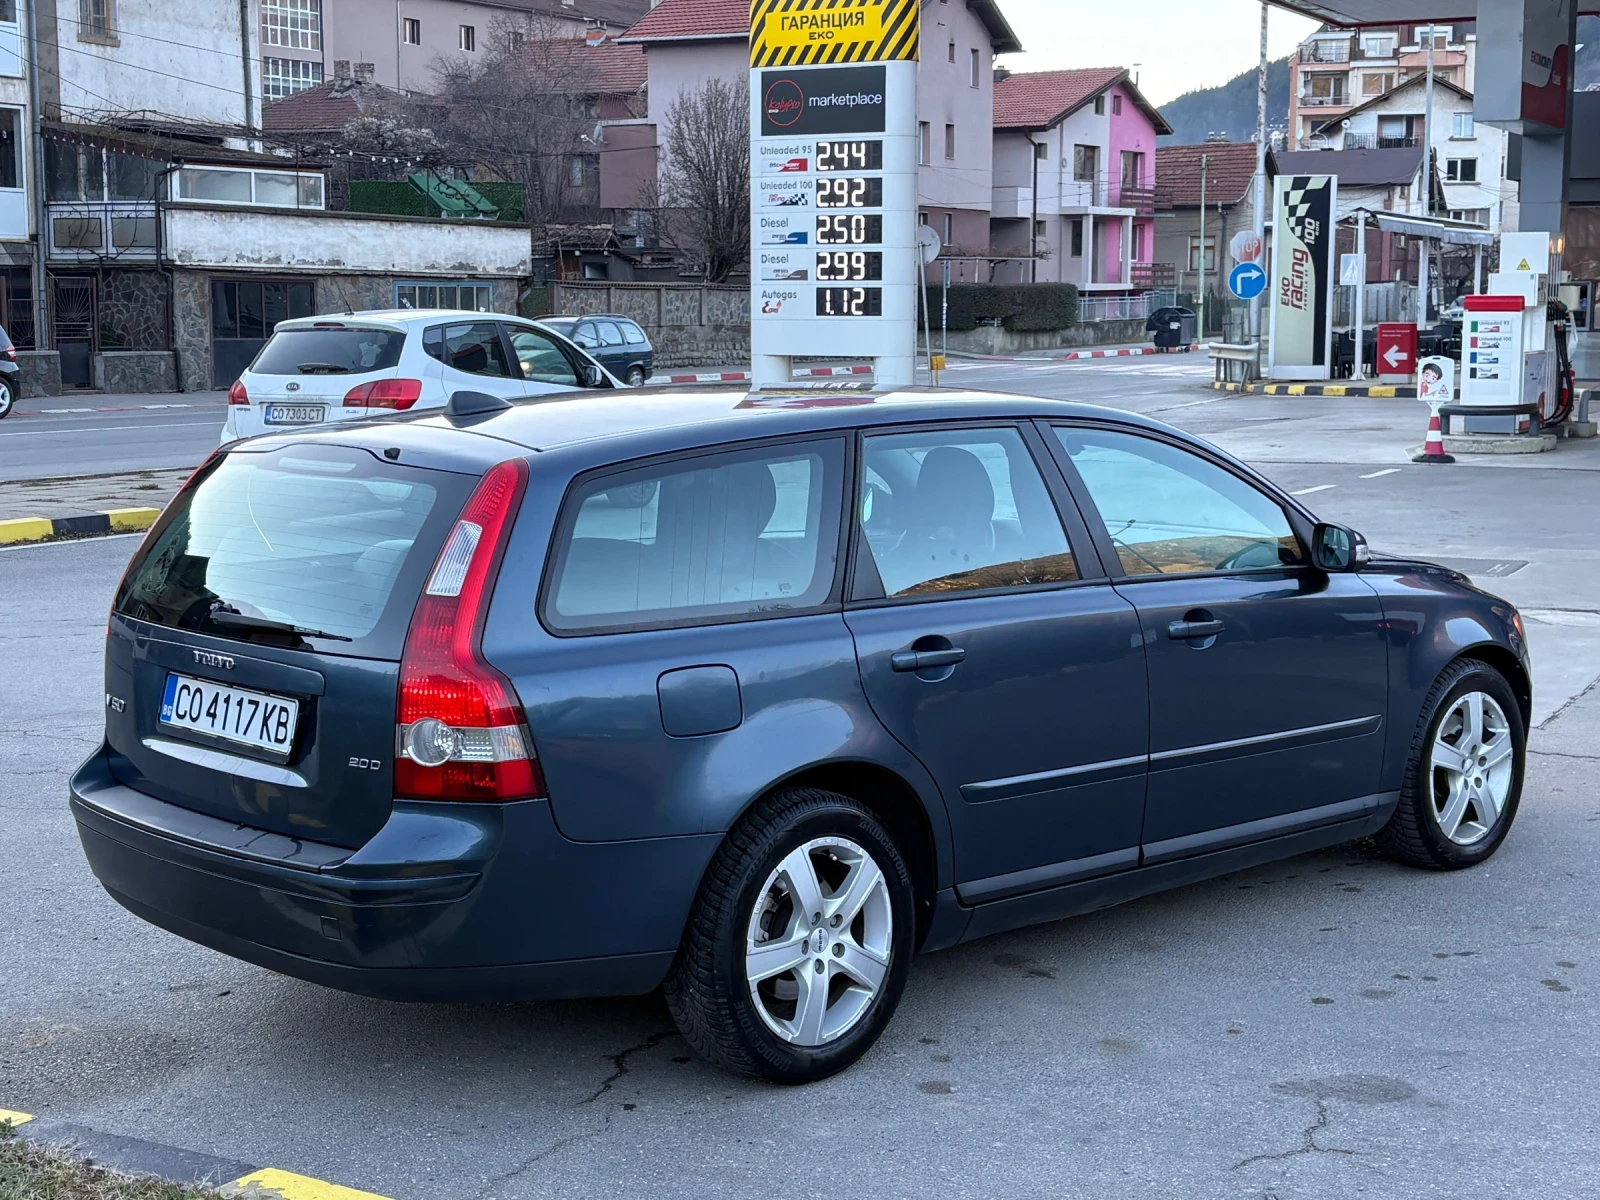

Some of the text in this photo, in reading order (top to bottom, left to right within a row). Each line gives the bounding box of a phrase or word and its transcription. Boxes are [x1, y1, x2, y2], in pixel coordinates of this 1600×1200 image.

[781, 11, 865, 31] ГАРАНЦИЯ
[809, 92, 882, 107] marketplace
[760, 145, 812, 155] Unleaded 95
[817, 142, 866, 170] 2.44
[760, 181, 813, 190] Unleaded 100
[817, 178, 866, 207] 2.92
[760, 218, 788, 228] Diesel
[817, 215, 866, 243] 2.50
[1304, 217, 1315, 244] 100
[761, 254, 789, 263] Diesel
[817, 252, 866, 280] 2.99
[1281, 276, 1290, 306] EKO
[1290, 247, 1308, 310] racing
[761, 290, 797, 301] Autogas
[825, 288, 865, 315] 1.12
